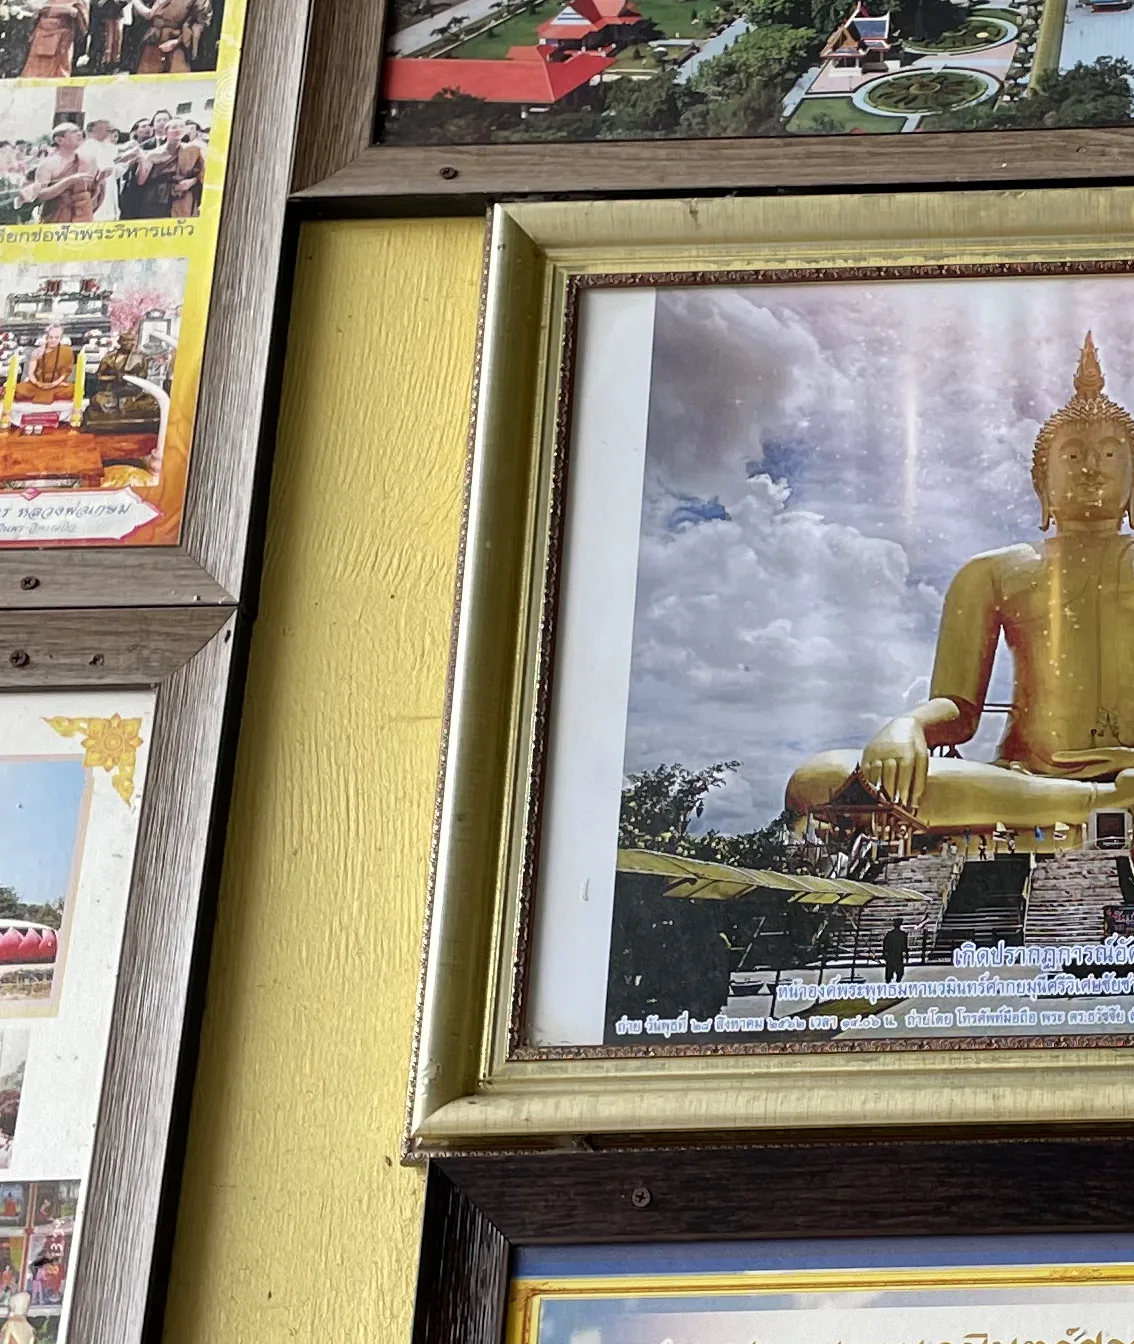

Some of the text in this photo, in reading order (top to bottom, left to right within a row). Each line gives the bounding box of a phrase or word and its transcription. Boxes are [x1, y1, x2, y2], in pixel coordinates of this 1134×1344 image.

[616, 1015, 642, 1034] ถ่าย
[714, 1013, 763, 1032] สิงหาคม
[809, 1015, 838, 1030] เวลา
[883, 1013, 898, 1028] น.
[906, 1007, 951, 1028] ถ่ายโดย
[1040, 1010, 1065, 1025] พระ
